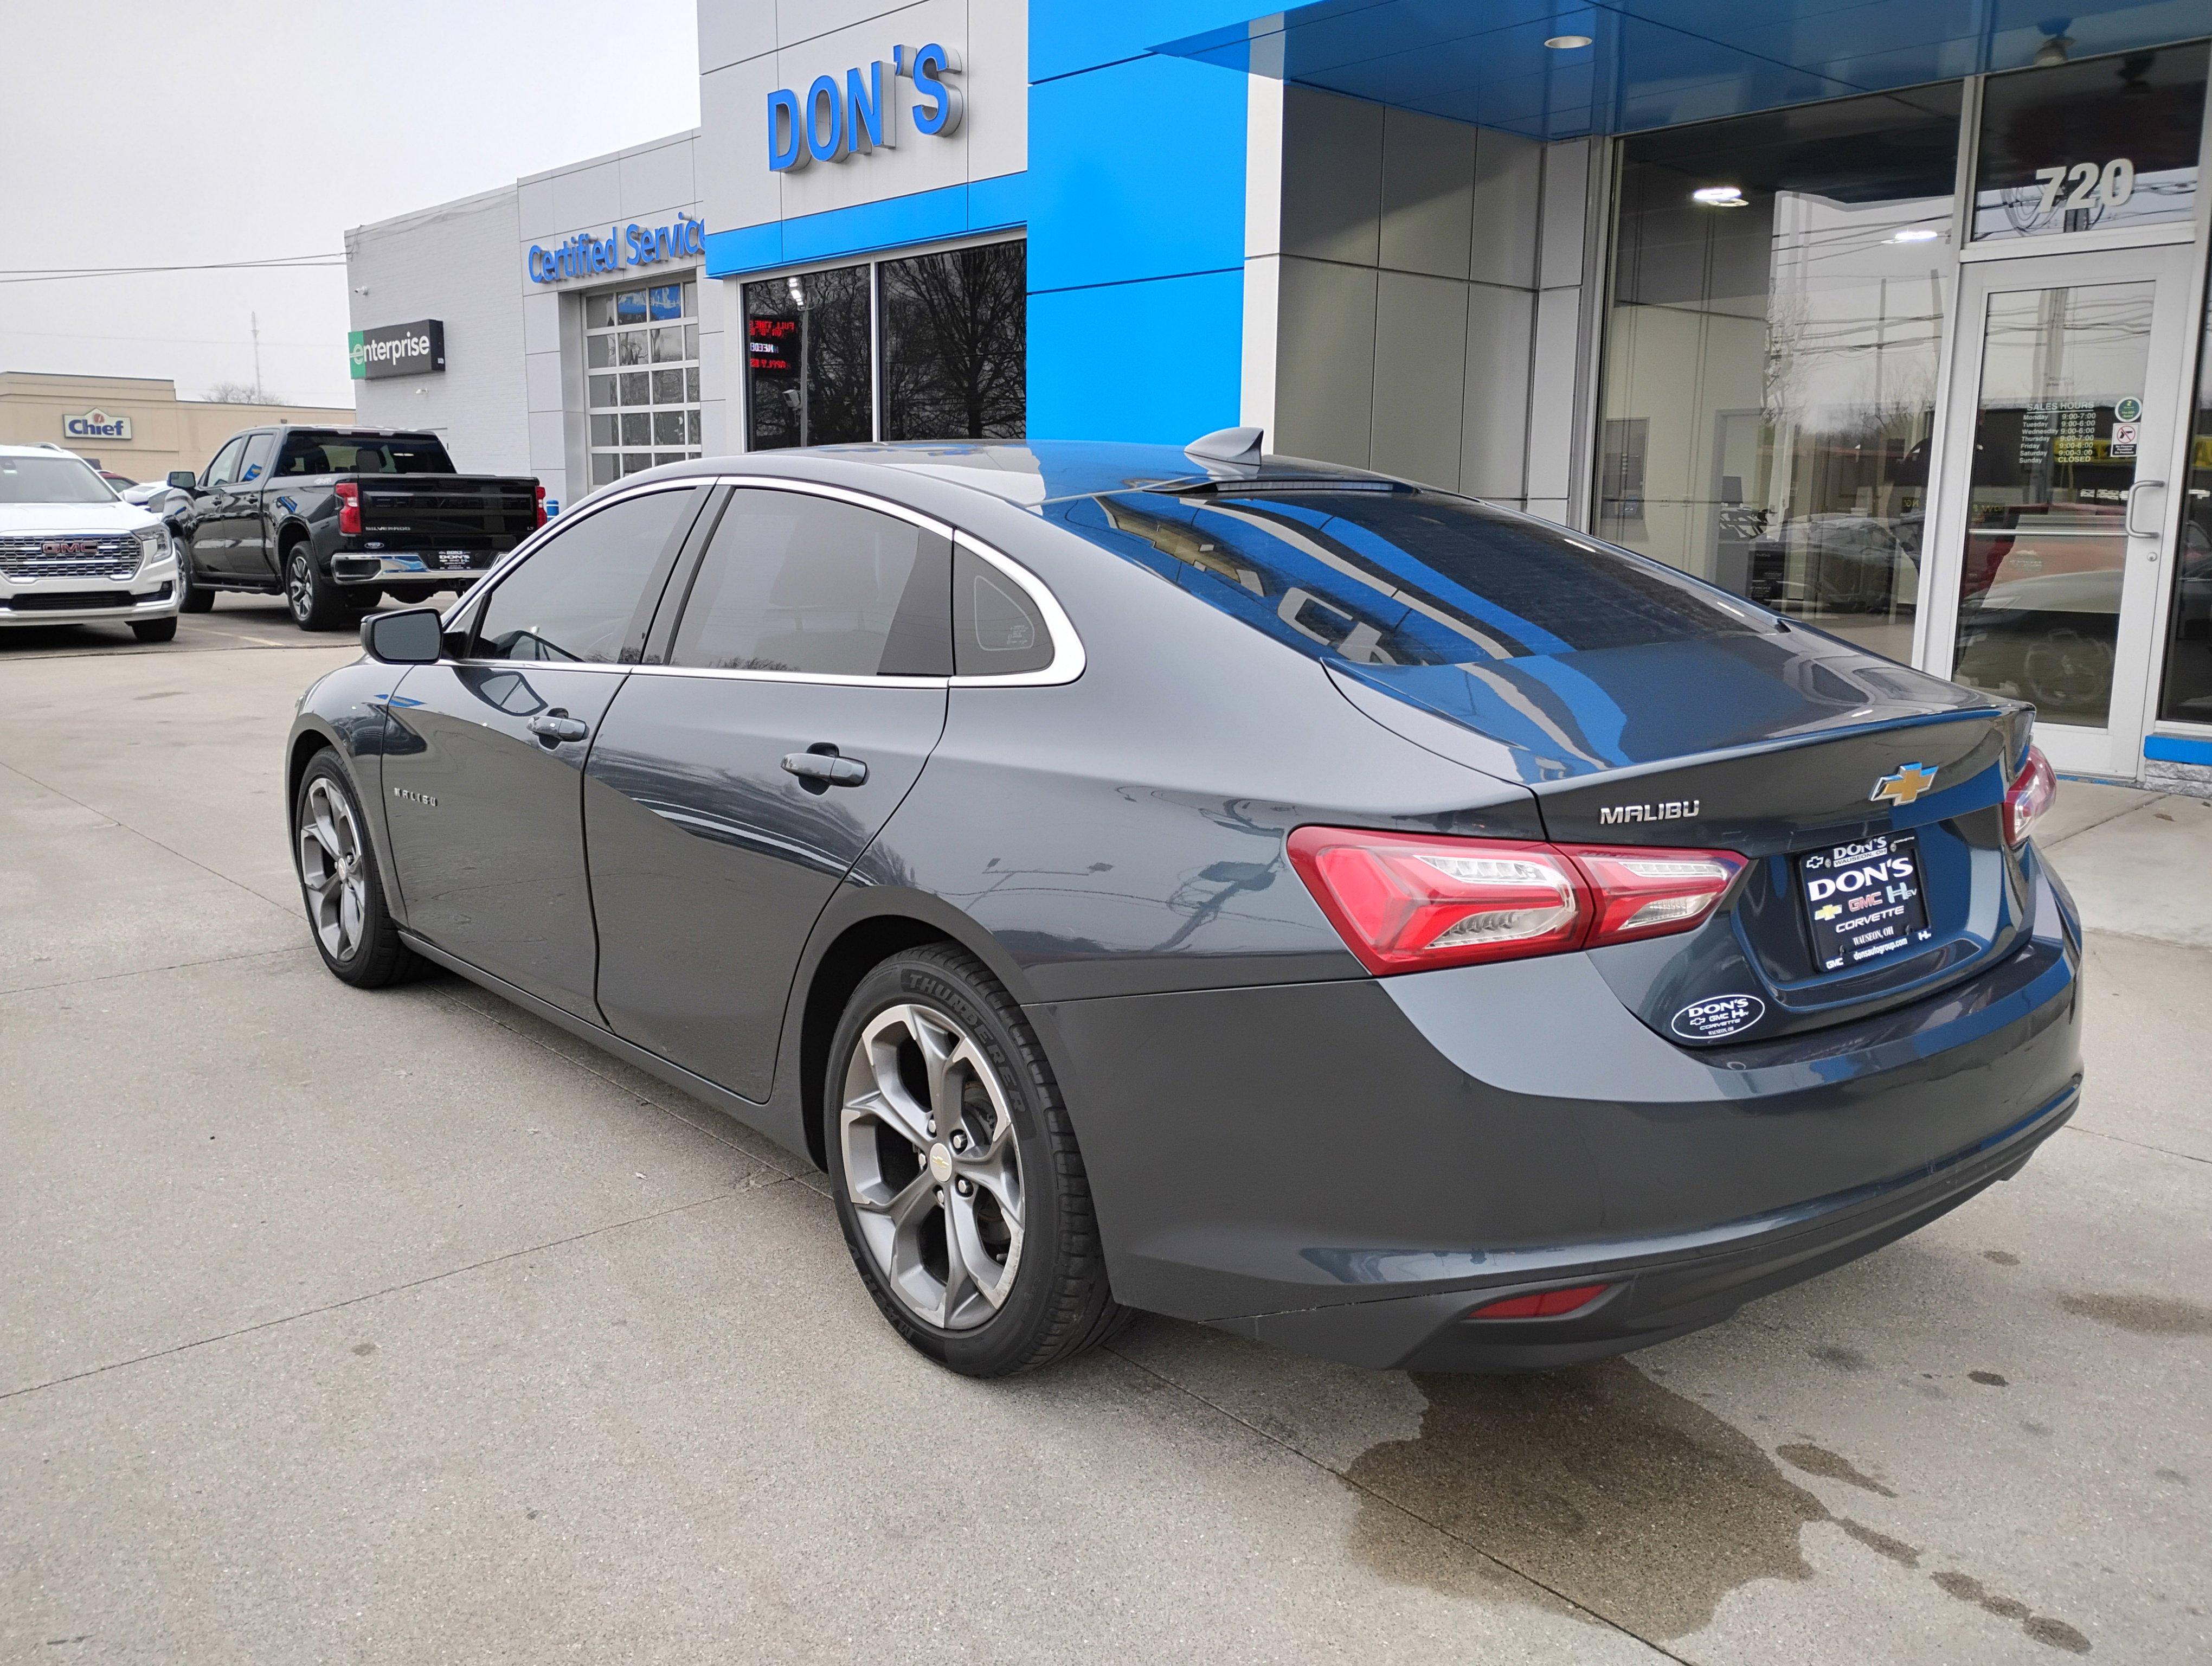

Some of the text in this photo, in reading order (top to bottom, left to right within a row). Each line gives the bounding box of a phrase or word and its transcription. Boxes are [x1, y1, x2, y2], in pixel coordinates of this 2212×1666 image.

[768, 43, 962, 172] DON'S
[2036, 158, 2134, 213] 720
[528, 226, 620, 283] Certified
[349, 331, 429, 366] enterprise
[2027, 401, 2094, 411] SALES HOURS
[68, 419, 124, 436] Chief
[43, 543, 98, 553] GMC
[394, 787, 438, 807] MALIBU
[1600, 800, 1699, 824] MALIBU
[1834, 836, 1887, 860] DON'S
[1808, 857, 1913, 901] DON'S
[1848, 891, 1883, 912] GMC
[1836, 905, 1905, 933] CORVETTE
[1883, 926, 1894, 937] OH
[1854, 938, 1908, 961] donsautogroup.com
[1826, 957, 1844, 970] GMC
[1688, 998, 1749, 1017] DON'S
[1709, 1013, 1729, 1022] GMC
[1699, 1018, 1741, 1031] CORVETTE
[910, 973, 1026, 1112] THUNDERER
